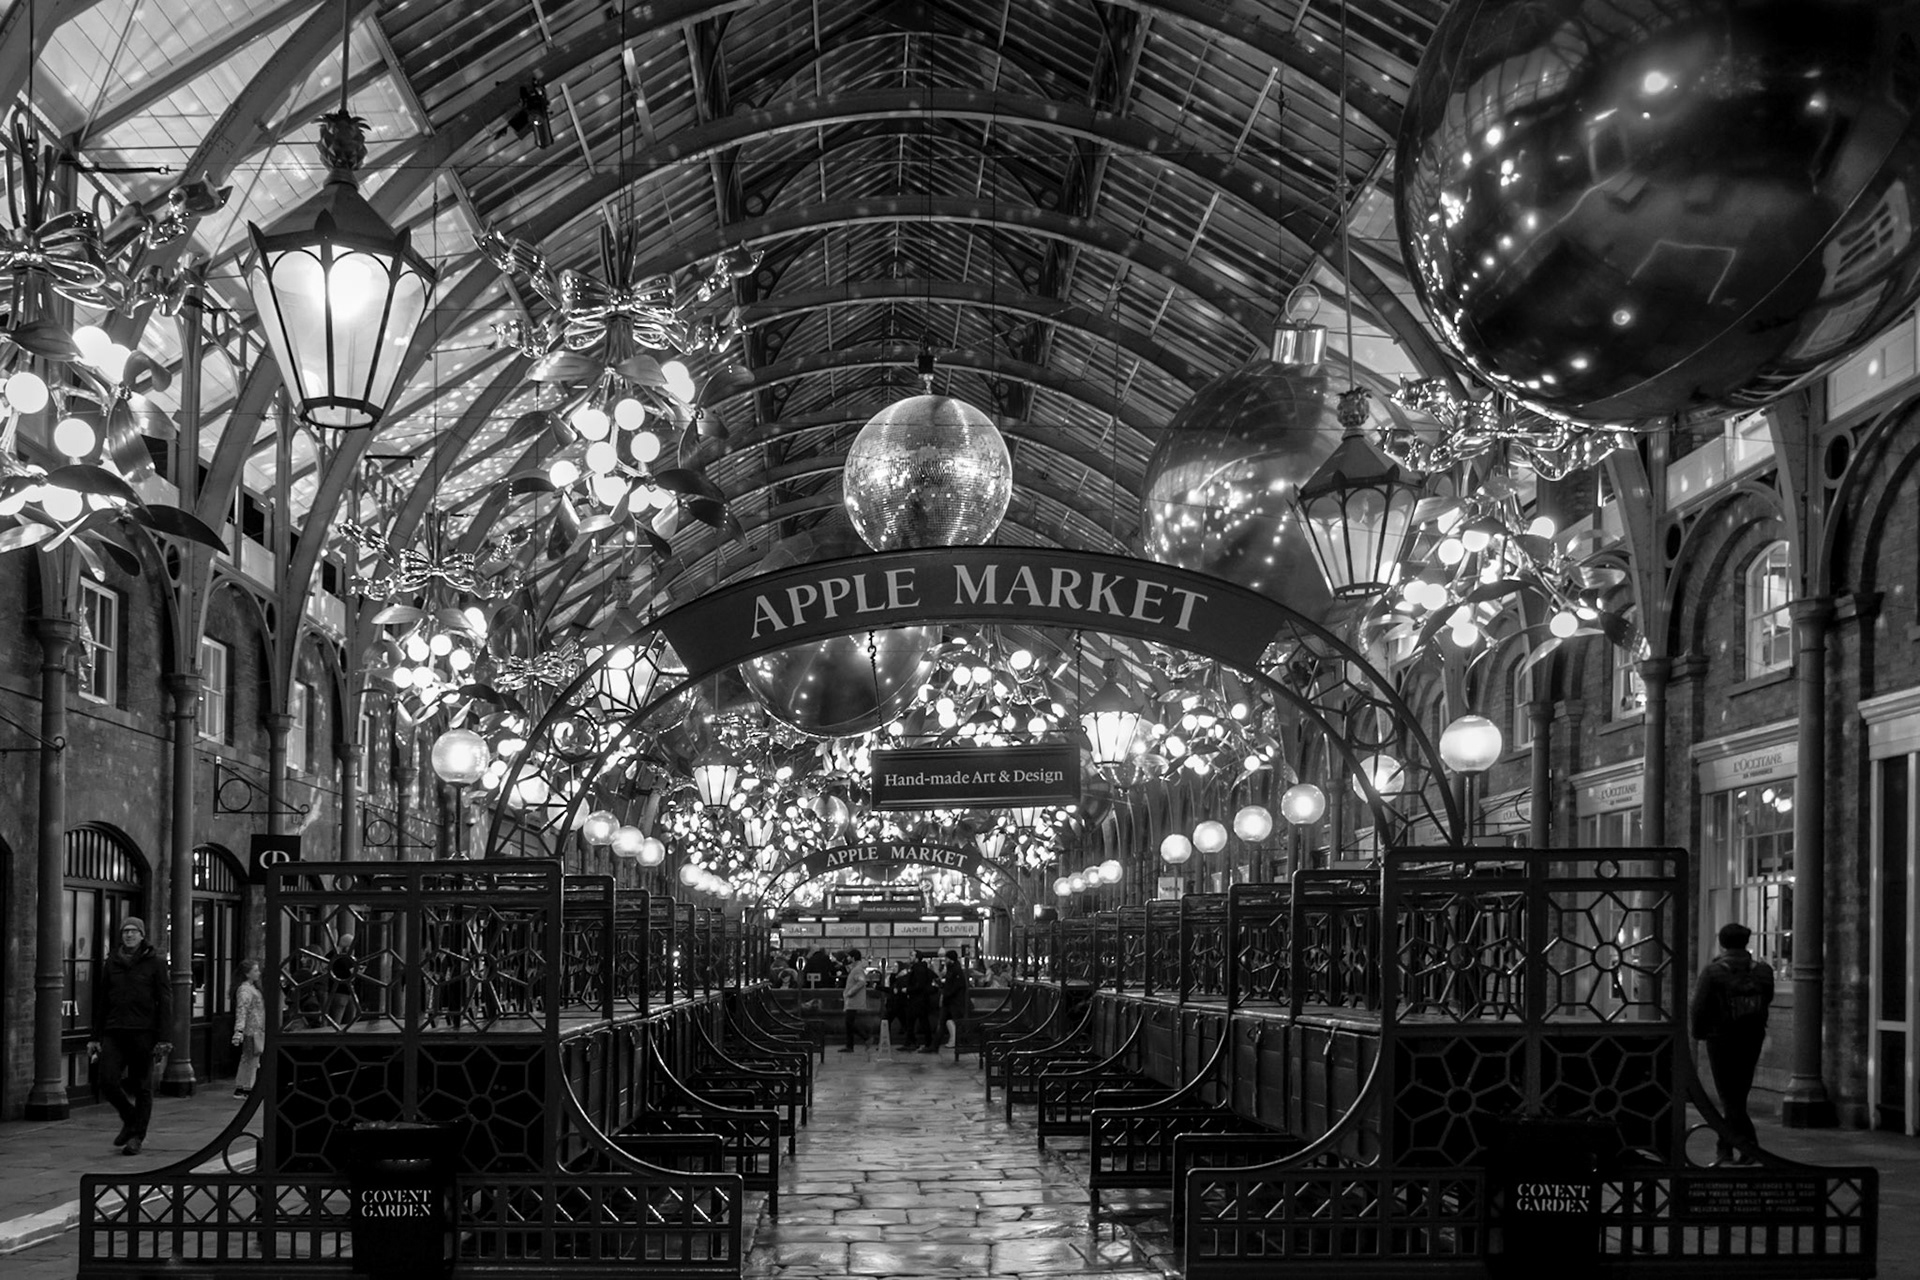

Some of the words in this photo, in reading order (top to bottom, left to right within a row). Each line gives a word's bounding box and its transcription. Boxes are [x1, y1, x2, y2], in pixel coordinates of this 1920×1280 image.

[751, 568, 921, 639] APPLE
[953, 564, 1208, 632] MARKET
[1733, 753, 1783, 773] L'OCCITANE
[884, 771, 970, 786] Hand-made
[971, 770, 996, 783] Art
[998, 770, 1011, 783] &
[1013, 768, 1064, 784] Design
[827, 846, 879, 867] APPLE
[890, 846, 968, 868] MARKET
[901, 926, 928, 934] JAMIE
[943, 926, 974, 934] OLIVER
[361, 1190, 432, 1203] COVENT
[1517, 1183, 1591, 1198] COVENT
[361, 1204, 431, 1217] GARDEN
[1516, 1198, 1589, 1213] GARDEN
